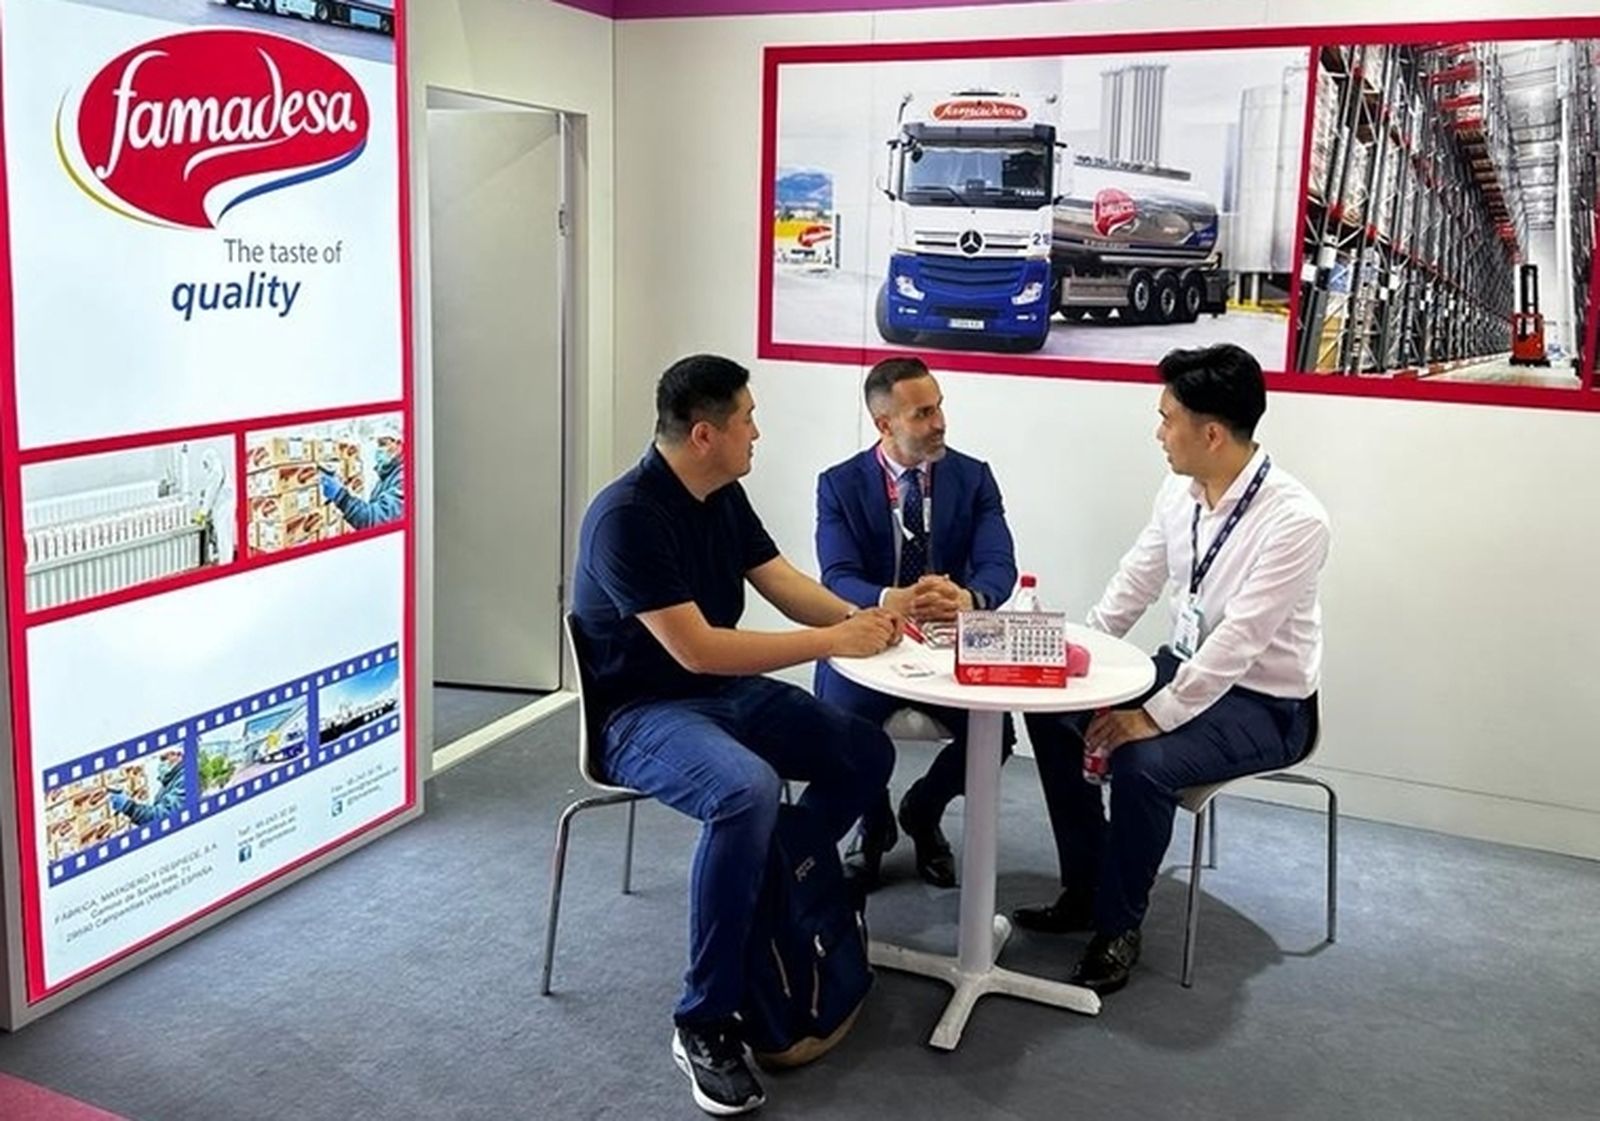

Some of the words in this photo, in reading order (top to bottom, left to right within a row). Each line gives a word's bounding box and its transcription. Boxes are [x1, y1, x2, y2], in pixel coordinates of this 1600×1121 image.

[94, 46, 358, 182] famadesa
[223, 238, 264, 264] The
[270, 241, 318, 264] taste
[322, 240, 343, 263] of
[171, 271, 301, 321] quality
